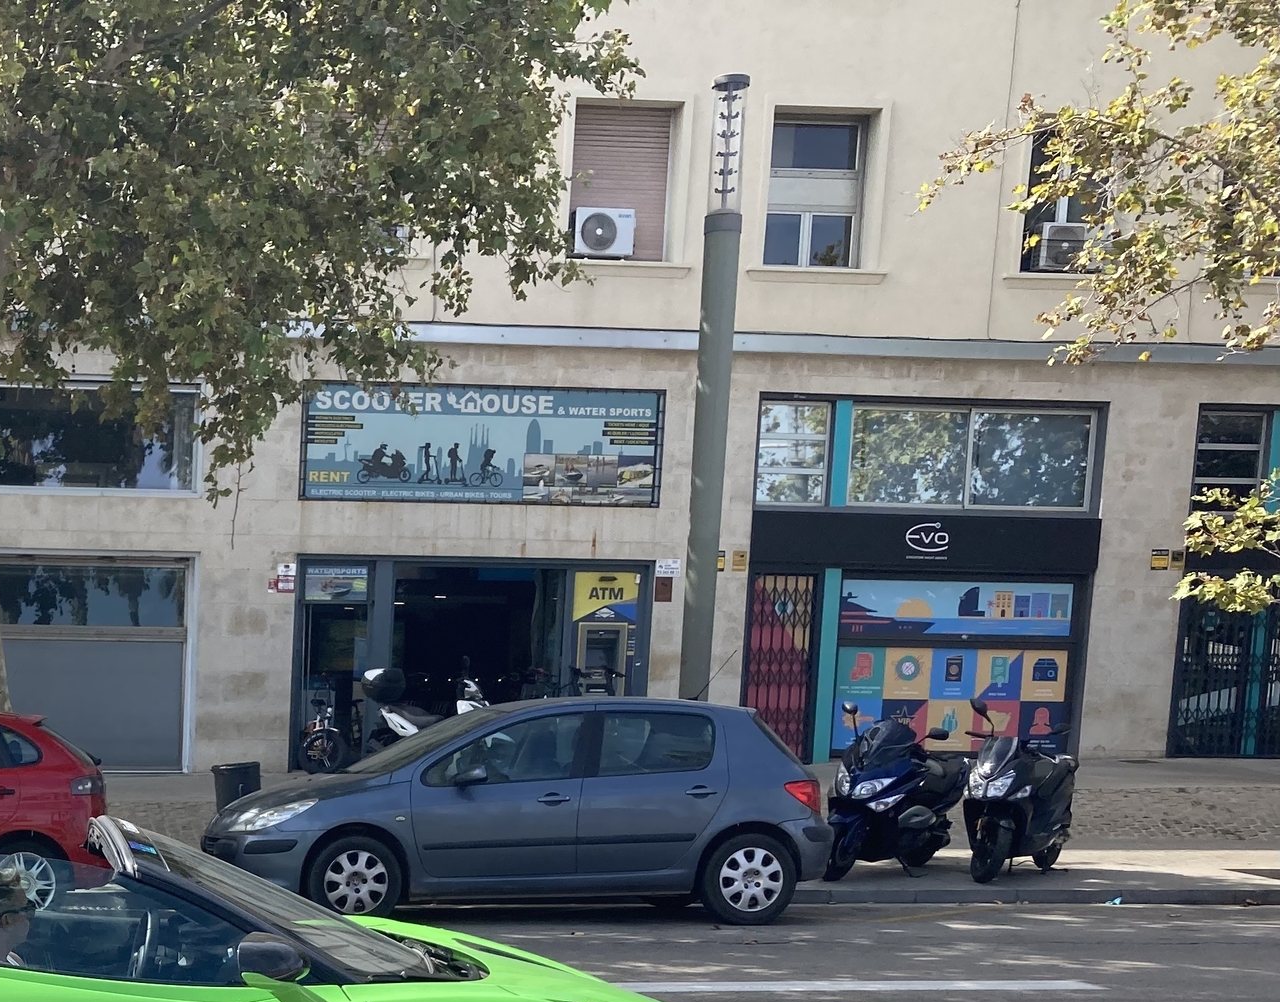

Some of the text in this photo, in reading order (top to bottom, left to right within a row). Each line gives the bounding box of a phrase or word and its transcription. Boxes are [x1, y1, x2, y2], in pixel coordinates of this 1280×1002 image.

[568, 406, 606, 416] WATER
[609, 407, 652, 417] SPORTS
[309, 470, 351, 483] RENT
[311, 488, 344, 496] ELECTRIC
[344, 489, 377, 497] SCOOTER
[415, 490, 435, 498] BIKES
[465, 491, 484, 499] BIKES
[905, 522, 949, 552] EVO
[334, 567, 367, 575] SPORTS
[588, 587, 624, 600] ATM
